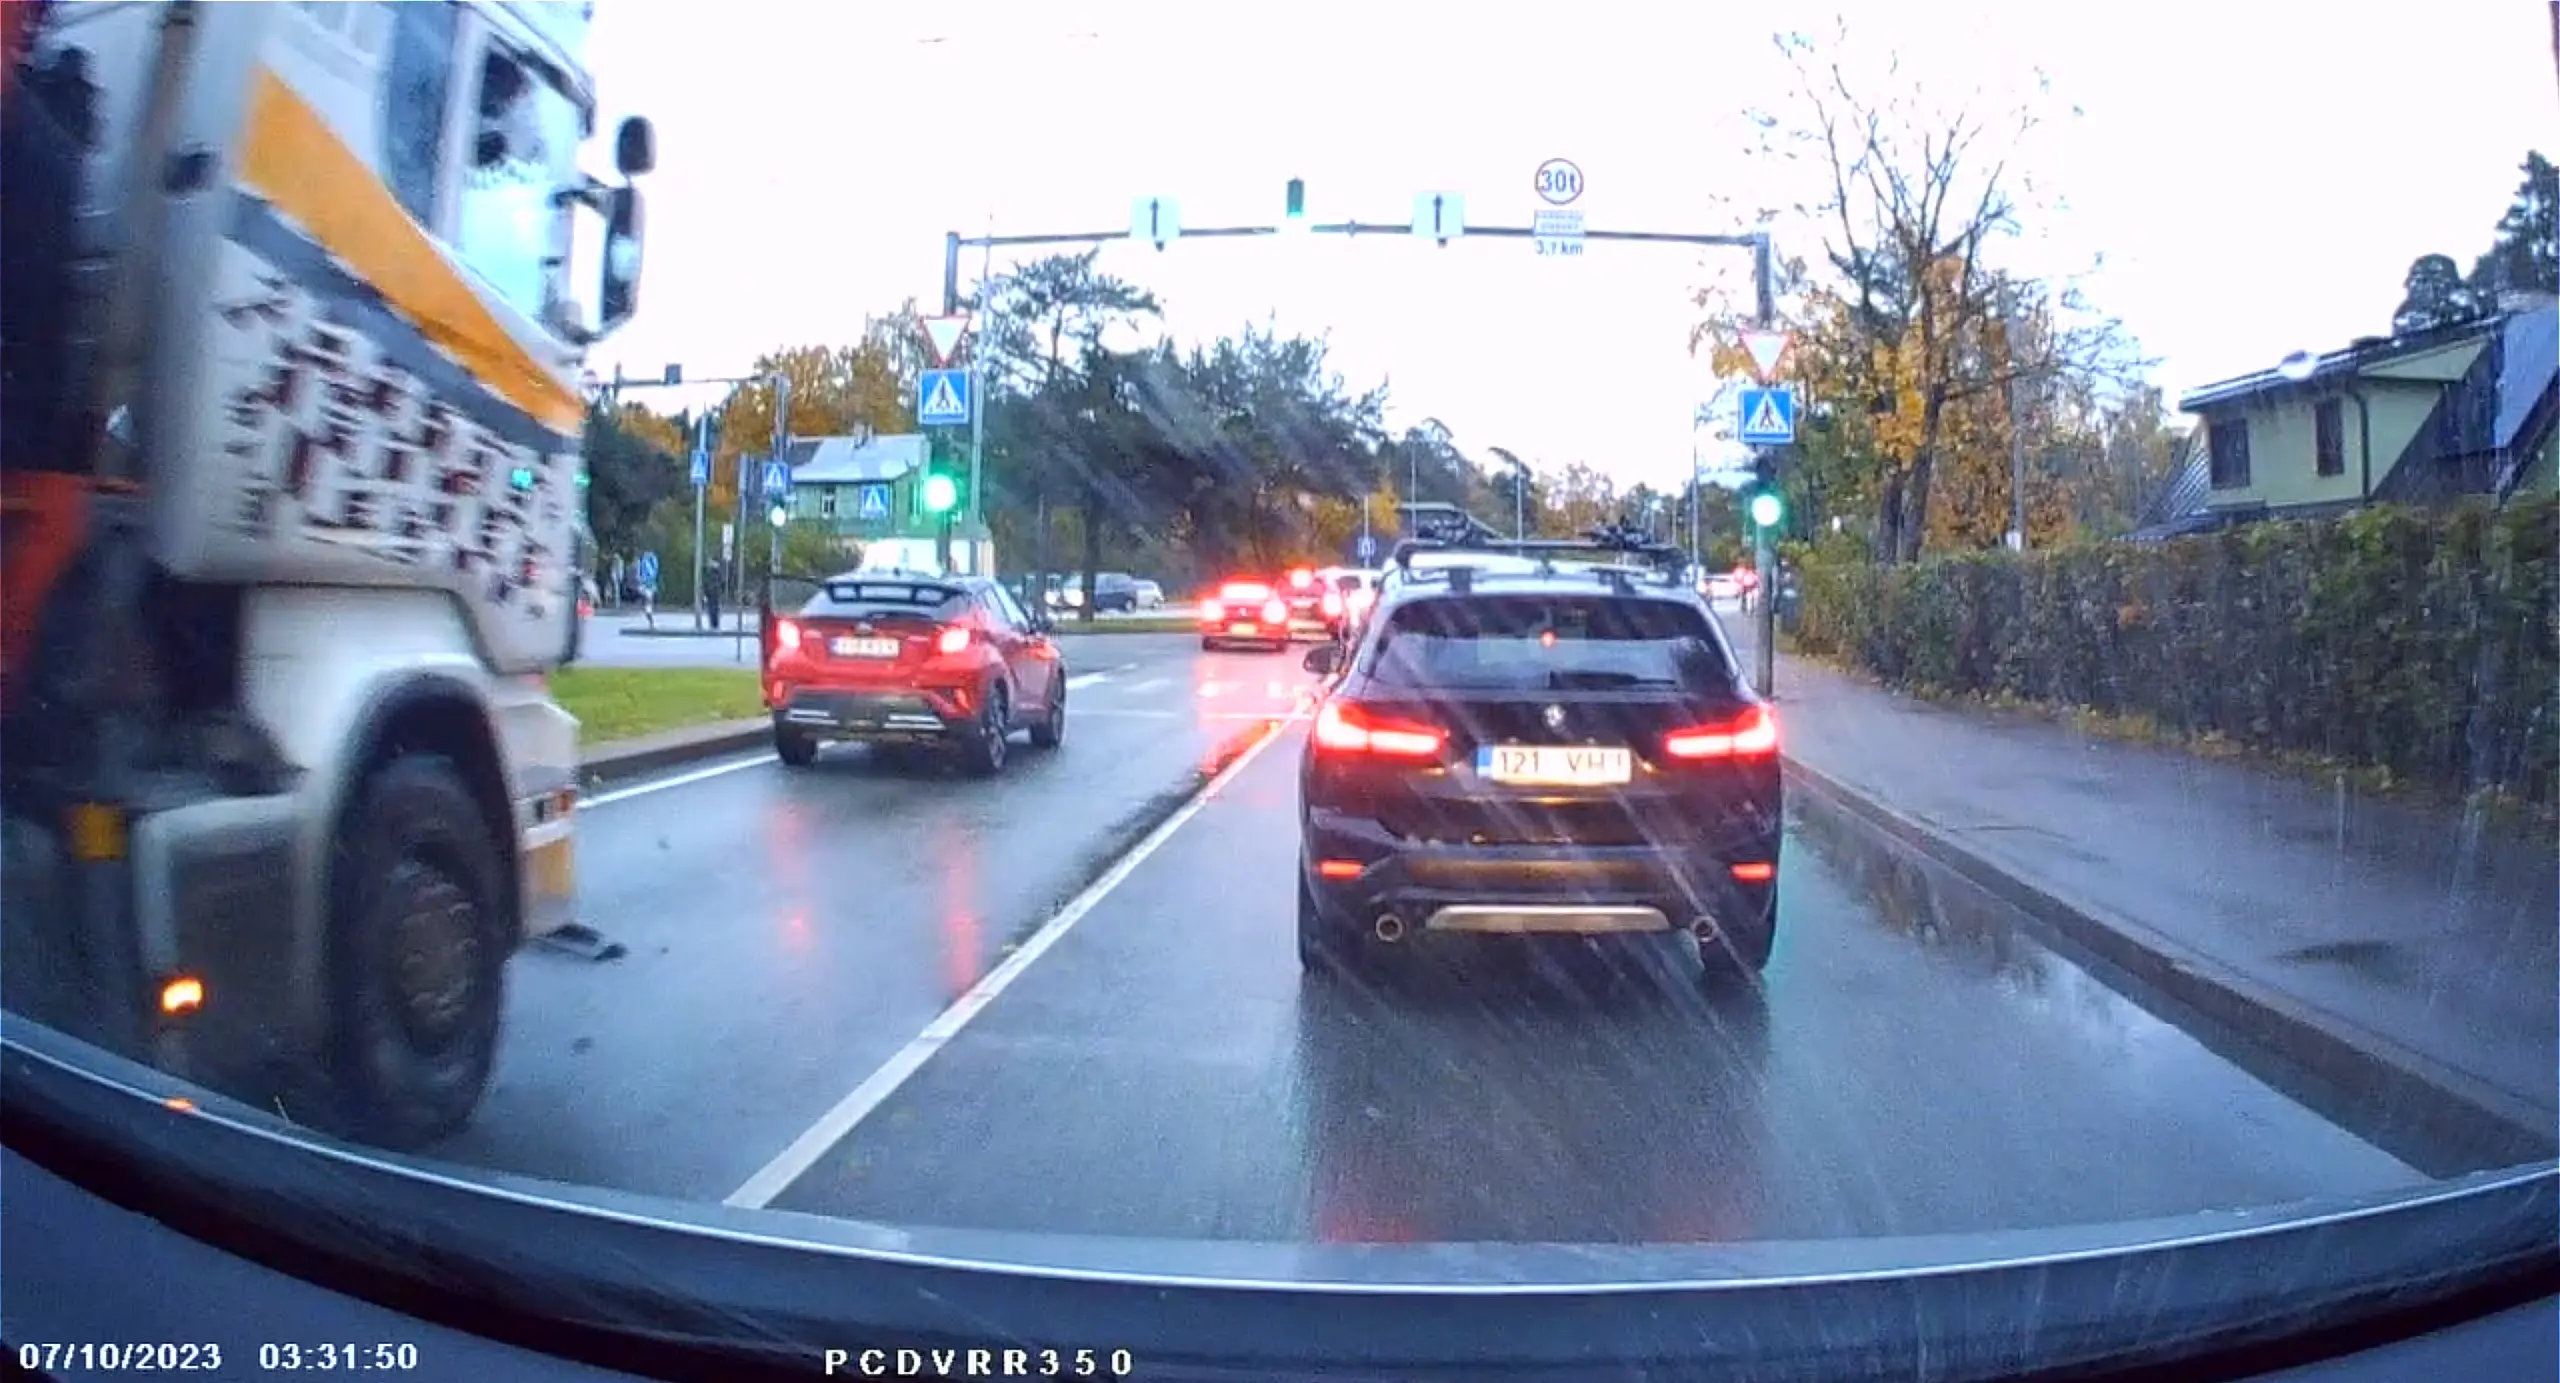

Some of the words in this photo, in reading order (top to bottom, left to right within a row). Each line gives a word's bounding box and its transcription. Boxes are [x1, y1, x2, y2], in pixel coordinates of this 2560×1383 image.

[1540, 168, 1577, 194] 30t
[1561, 240, 1584, 256] km
[1501, 751, 1540, 774] 121
